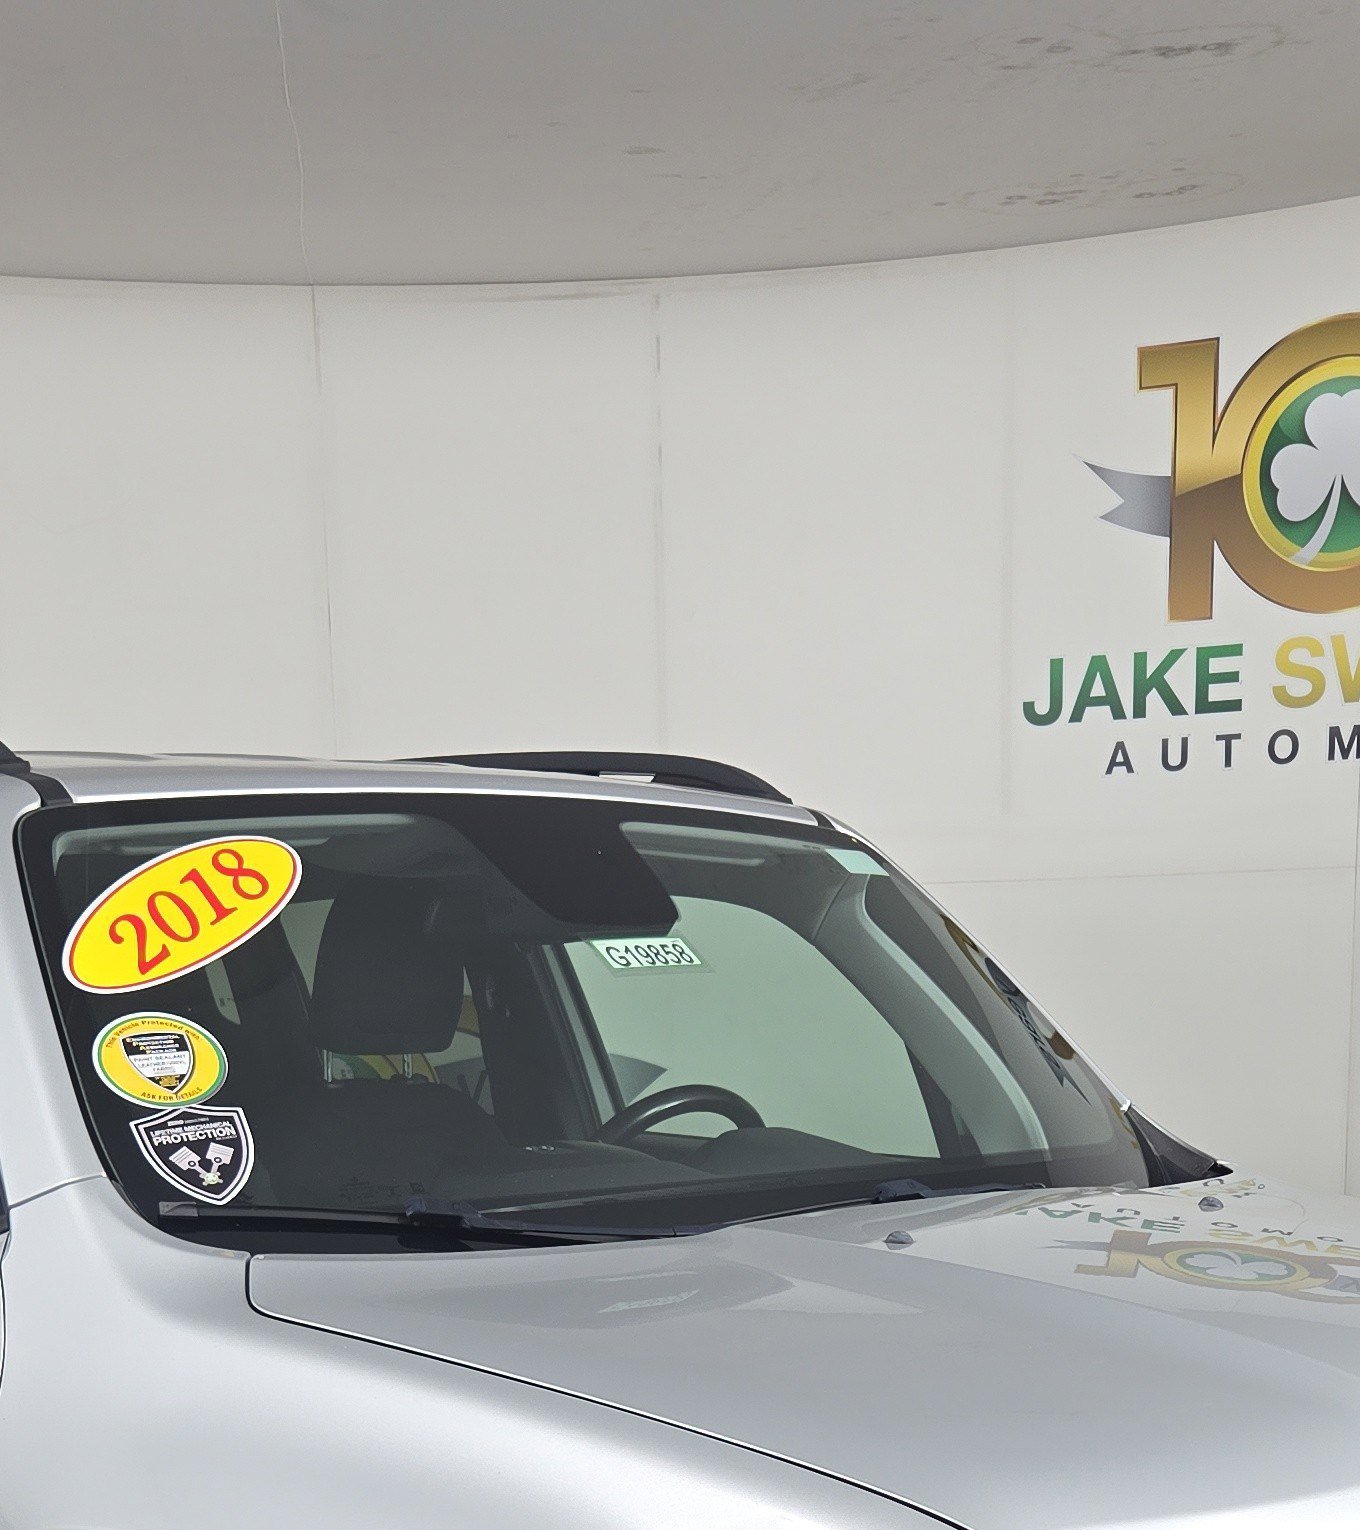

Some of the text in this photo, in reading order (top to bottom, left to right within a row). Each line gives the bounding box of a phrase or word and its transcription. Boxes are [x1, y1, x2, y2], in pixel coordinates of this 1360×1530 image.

[1022, 642, 1244, 727] JAKE
[109, 848, 270, 975] 2018
[605, 943, 695, 967] G19858
[152, 1125, 237, 1146] PROTECTION
